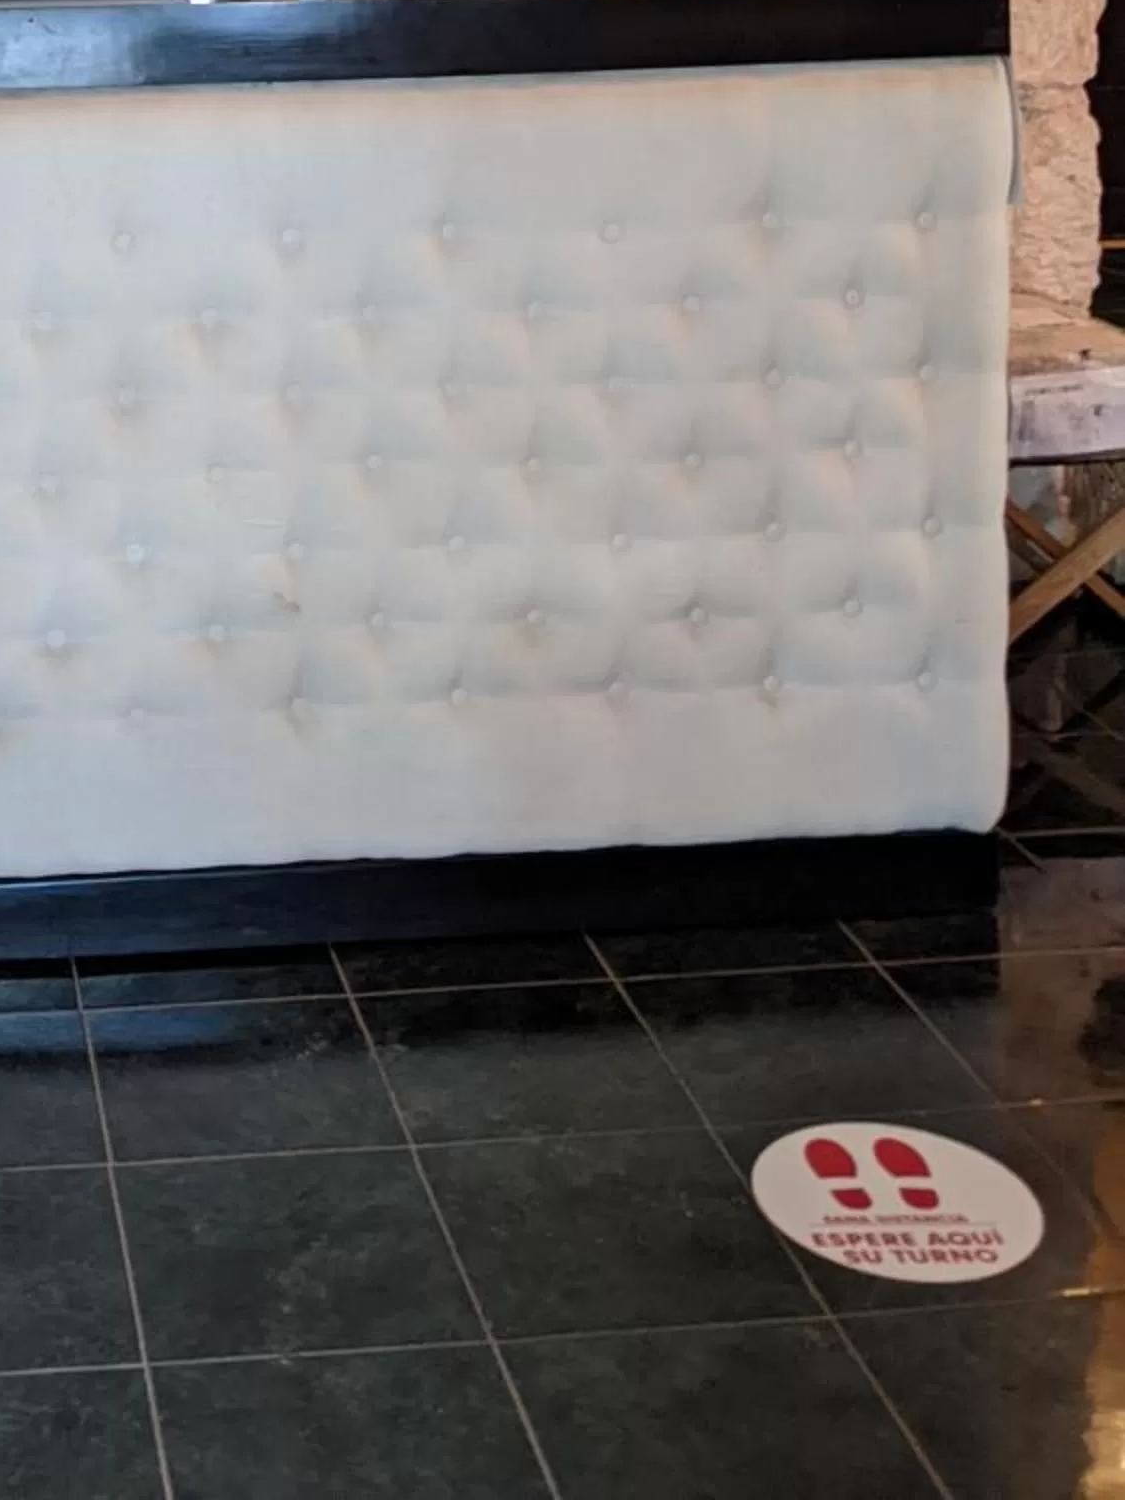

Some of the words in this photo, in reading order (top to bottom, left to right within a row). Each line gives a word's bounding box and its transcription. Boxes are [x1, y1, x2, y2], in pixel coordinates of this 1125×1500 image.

[875, 1215, 969, 1224] DISTANCIA
[811, 1232, 917, 1247] ESPERE
[927, 1228, 1004, 1246] AQUÍ
[842, 1249, 884, 1265] SU
[888, 1249, 999, 1264] TURNO
